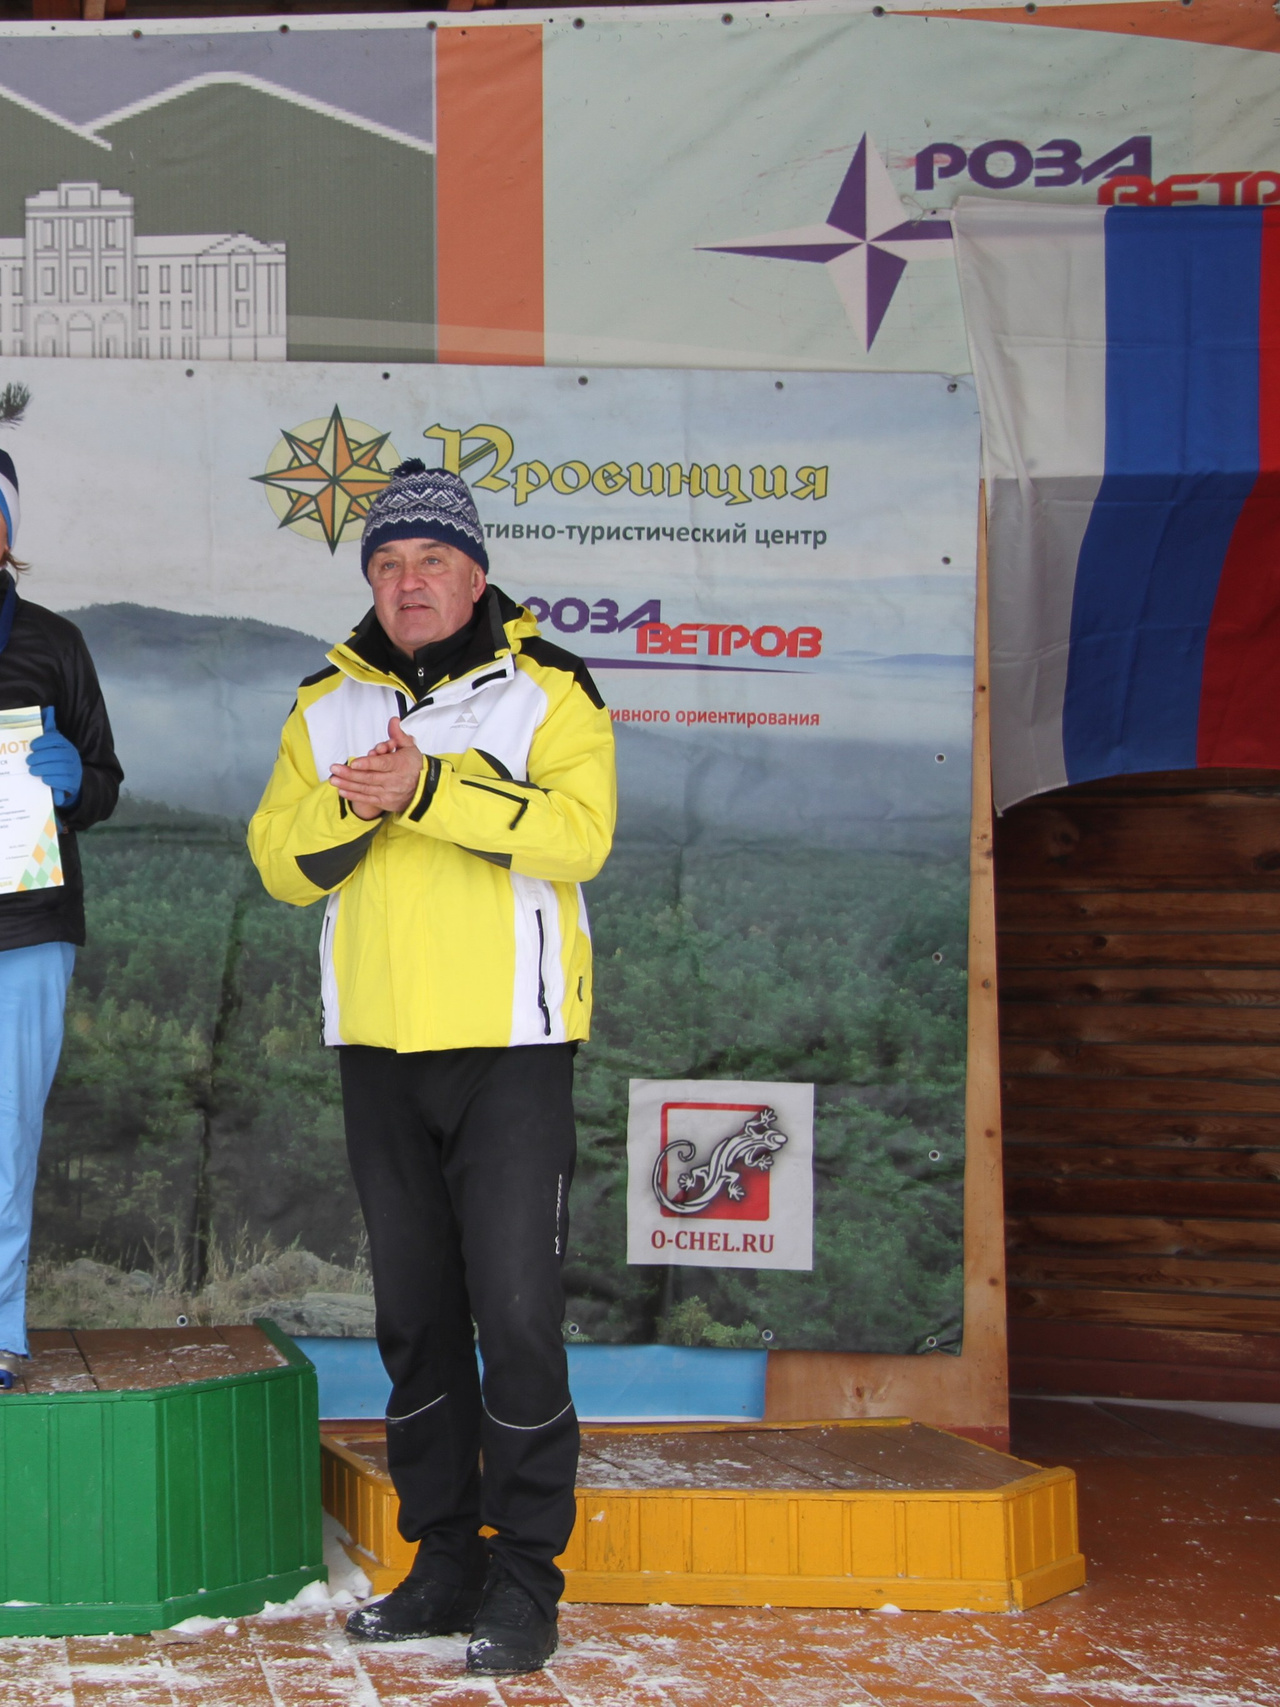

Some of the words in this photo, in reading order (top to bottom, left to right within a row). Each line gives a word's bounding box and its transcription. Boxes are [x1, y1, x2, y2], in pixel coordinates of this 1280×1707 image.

[915, 135, 1152, 191] РОЗА
[423, 423, 828, 506] Провинция
[484, 522, 747, 545] тивно-туристический
[755, 528, 827, 549] центр
[522, 596, 661, 634] РОЗА
[636, 622, 823, 658] ВЕТРОВ
[610, 708, 670, 723] ивного
[675, 710, 820, 728] ориентирования
[651, 1229, 775, 1253] O-CHEL.RU
